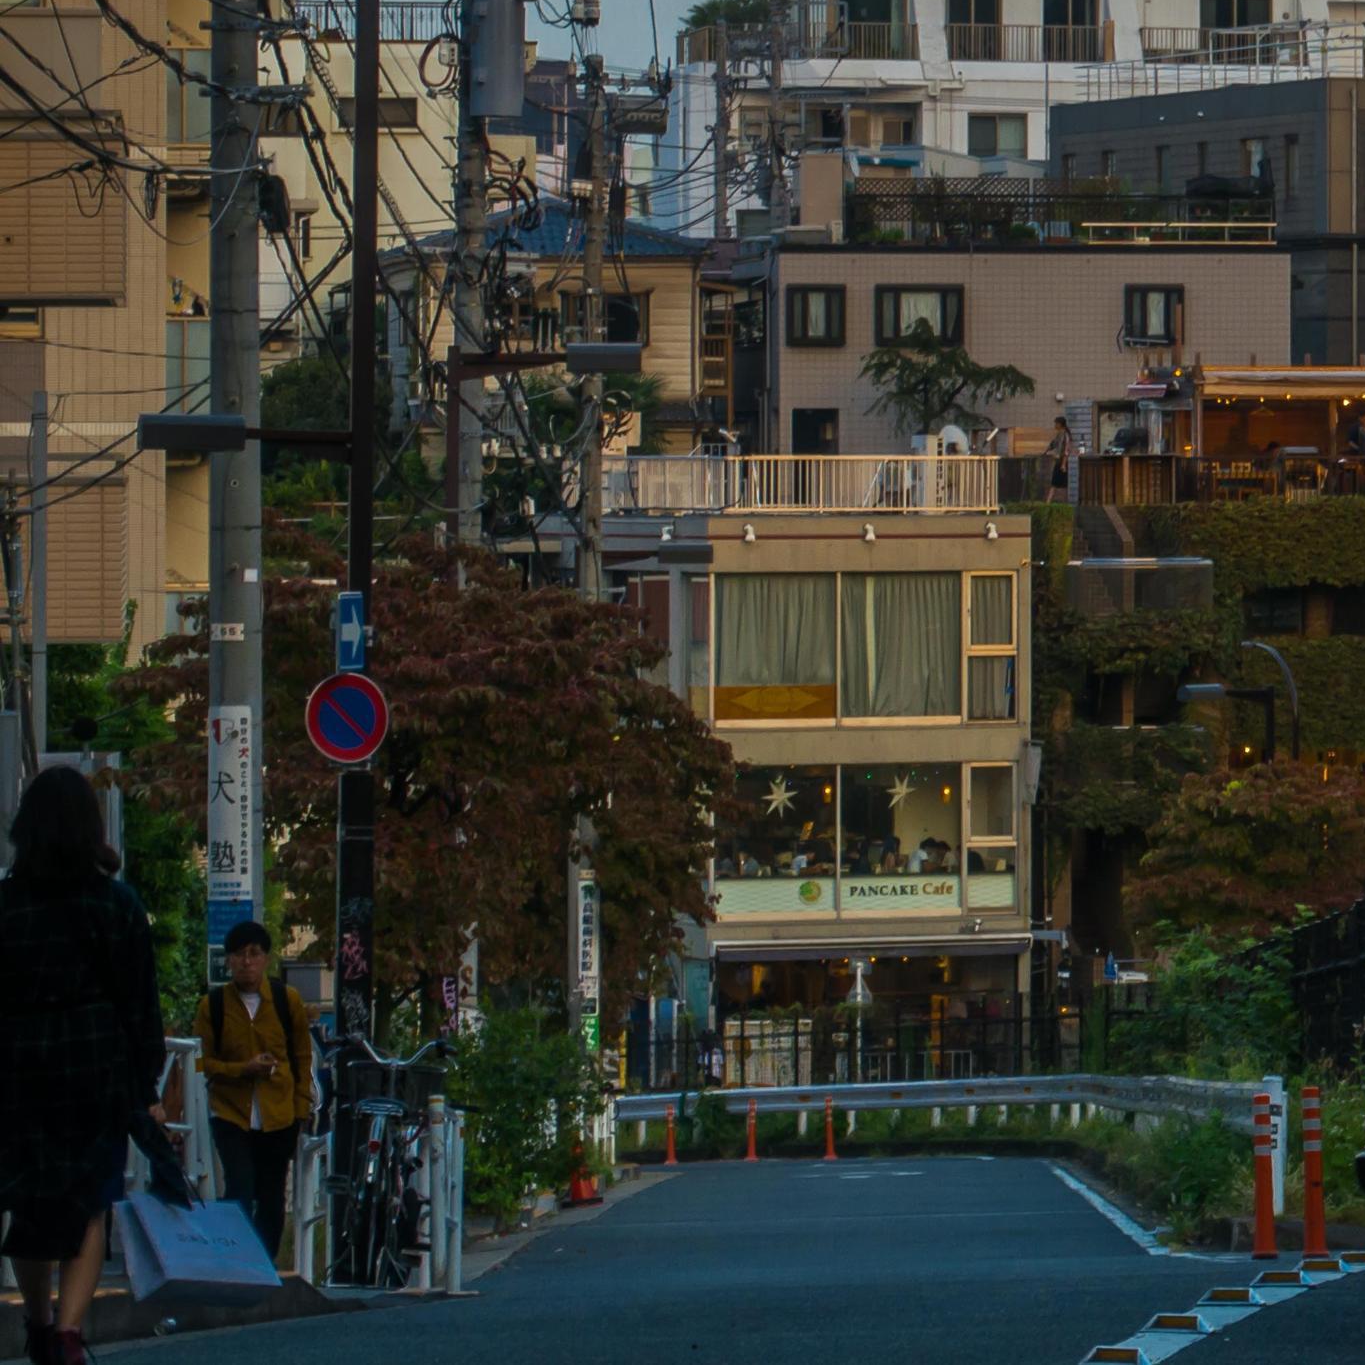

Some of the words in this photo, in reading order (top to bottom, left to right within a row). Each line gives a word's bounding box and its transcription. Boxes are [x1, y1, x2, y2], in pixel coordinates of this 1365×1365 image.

[211, 770, 236, 874] 犬塾
[849, 884, 919, 897] PANCAKE
[922, 881, 953, 895] Cafe
